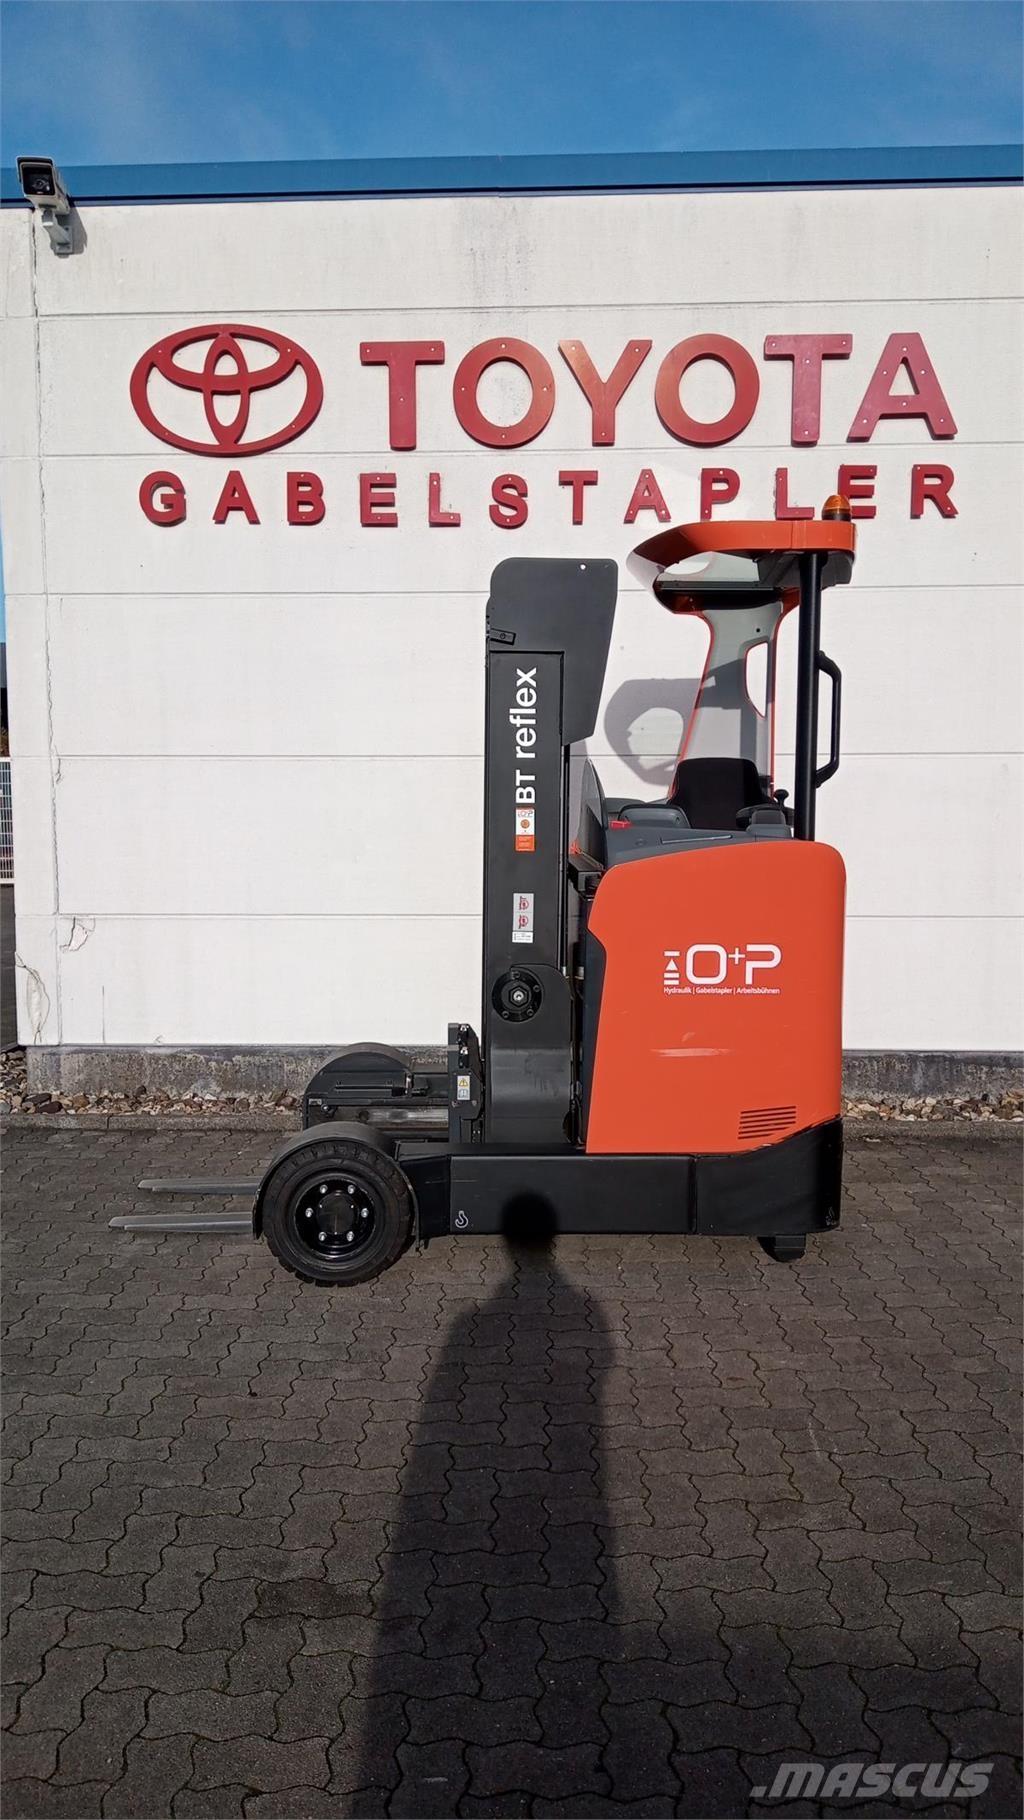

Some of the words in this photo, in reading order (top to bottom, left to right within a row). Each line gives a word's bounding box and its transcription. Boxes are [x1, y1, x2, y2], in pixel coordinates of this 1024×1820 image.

[360, 333, 956, 451] TOYOTA
[139, 464, 958, 528] GABELSTAPLER
[509, 667, 537, 758] reflex
[516, 770, 535, 803] BT
[663, 986, 692, 996] Hydraulik
[695, 986, 733, 996] Gabelstapler
[736, 986, 780, 995] Arbeitsbühnen
